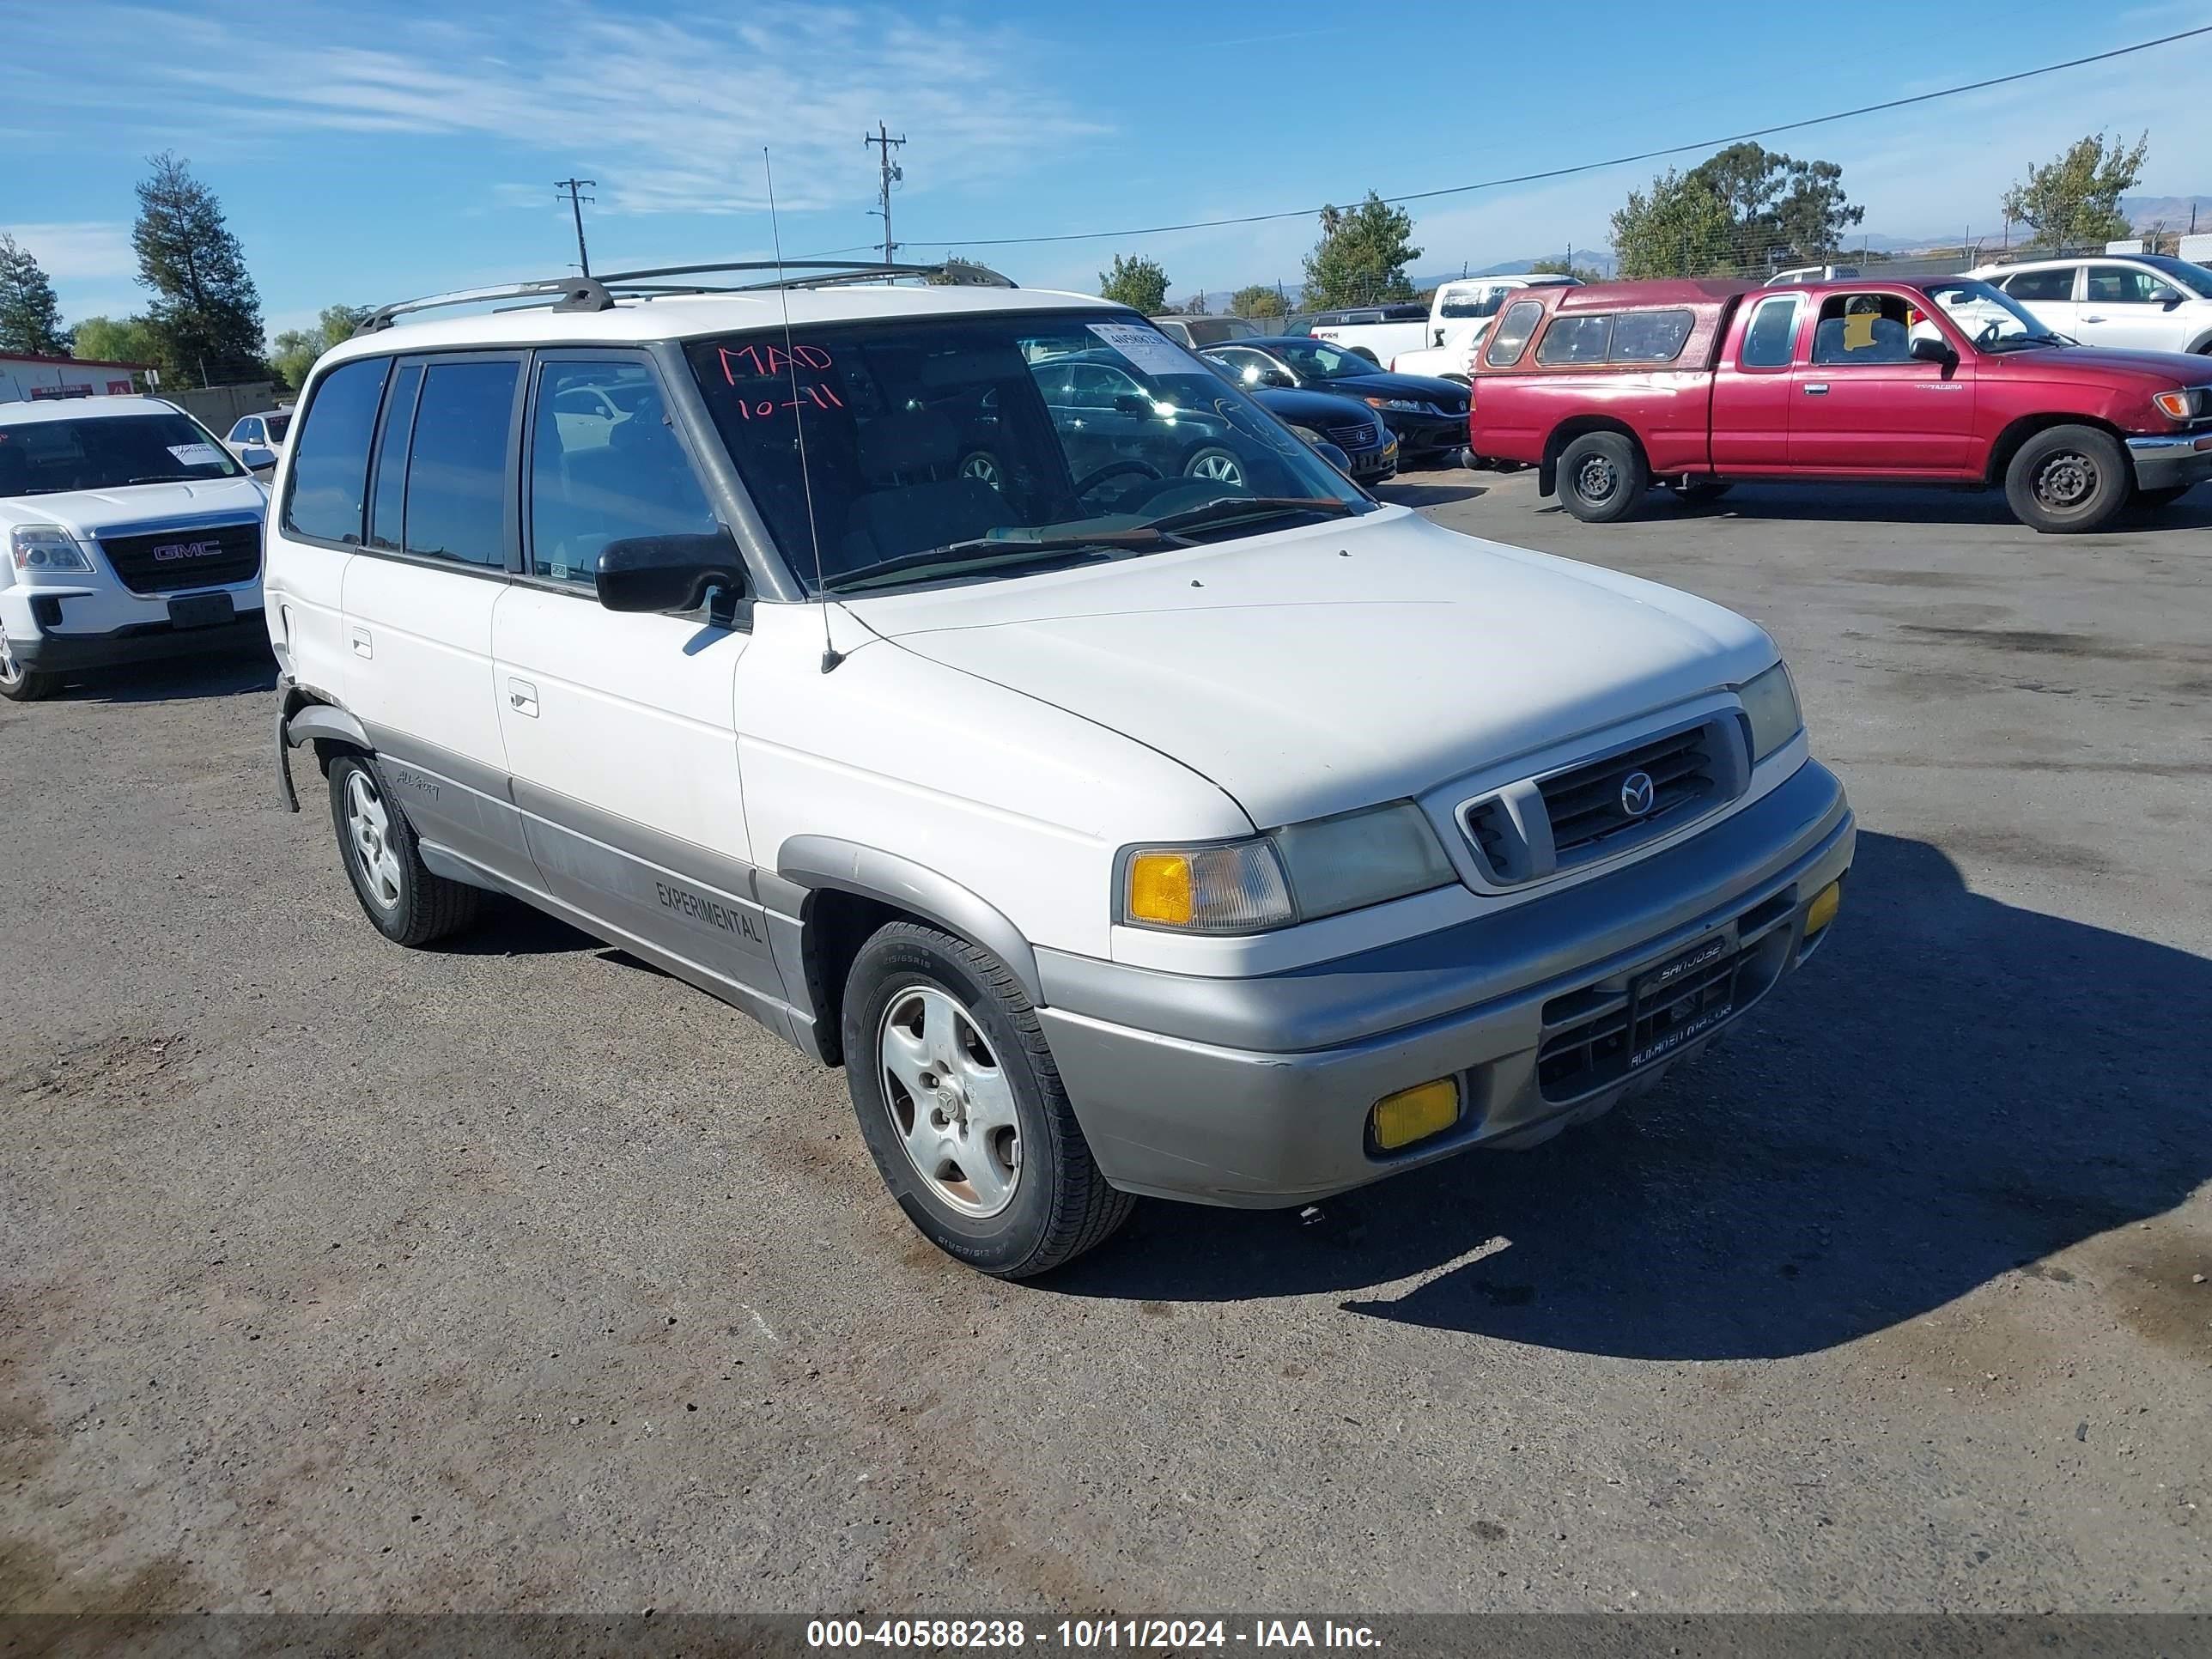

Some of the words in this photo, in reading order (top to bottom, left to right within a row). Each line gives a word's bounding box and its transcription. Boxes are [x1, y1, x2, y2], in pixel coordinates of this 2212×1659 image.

[718, 345, 832, 386] MAD
[154, 540, 222, 561] GMC
[656, 881, 763, 944] EXPERIMENTAL
